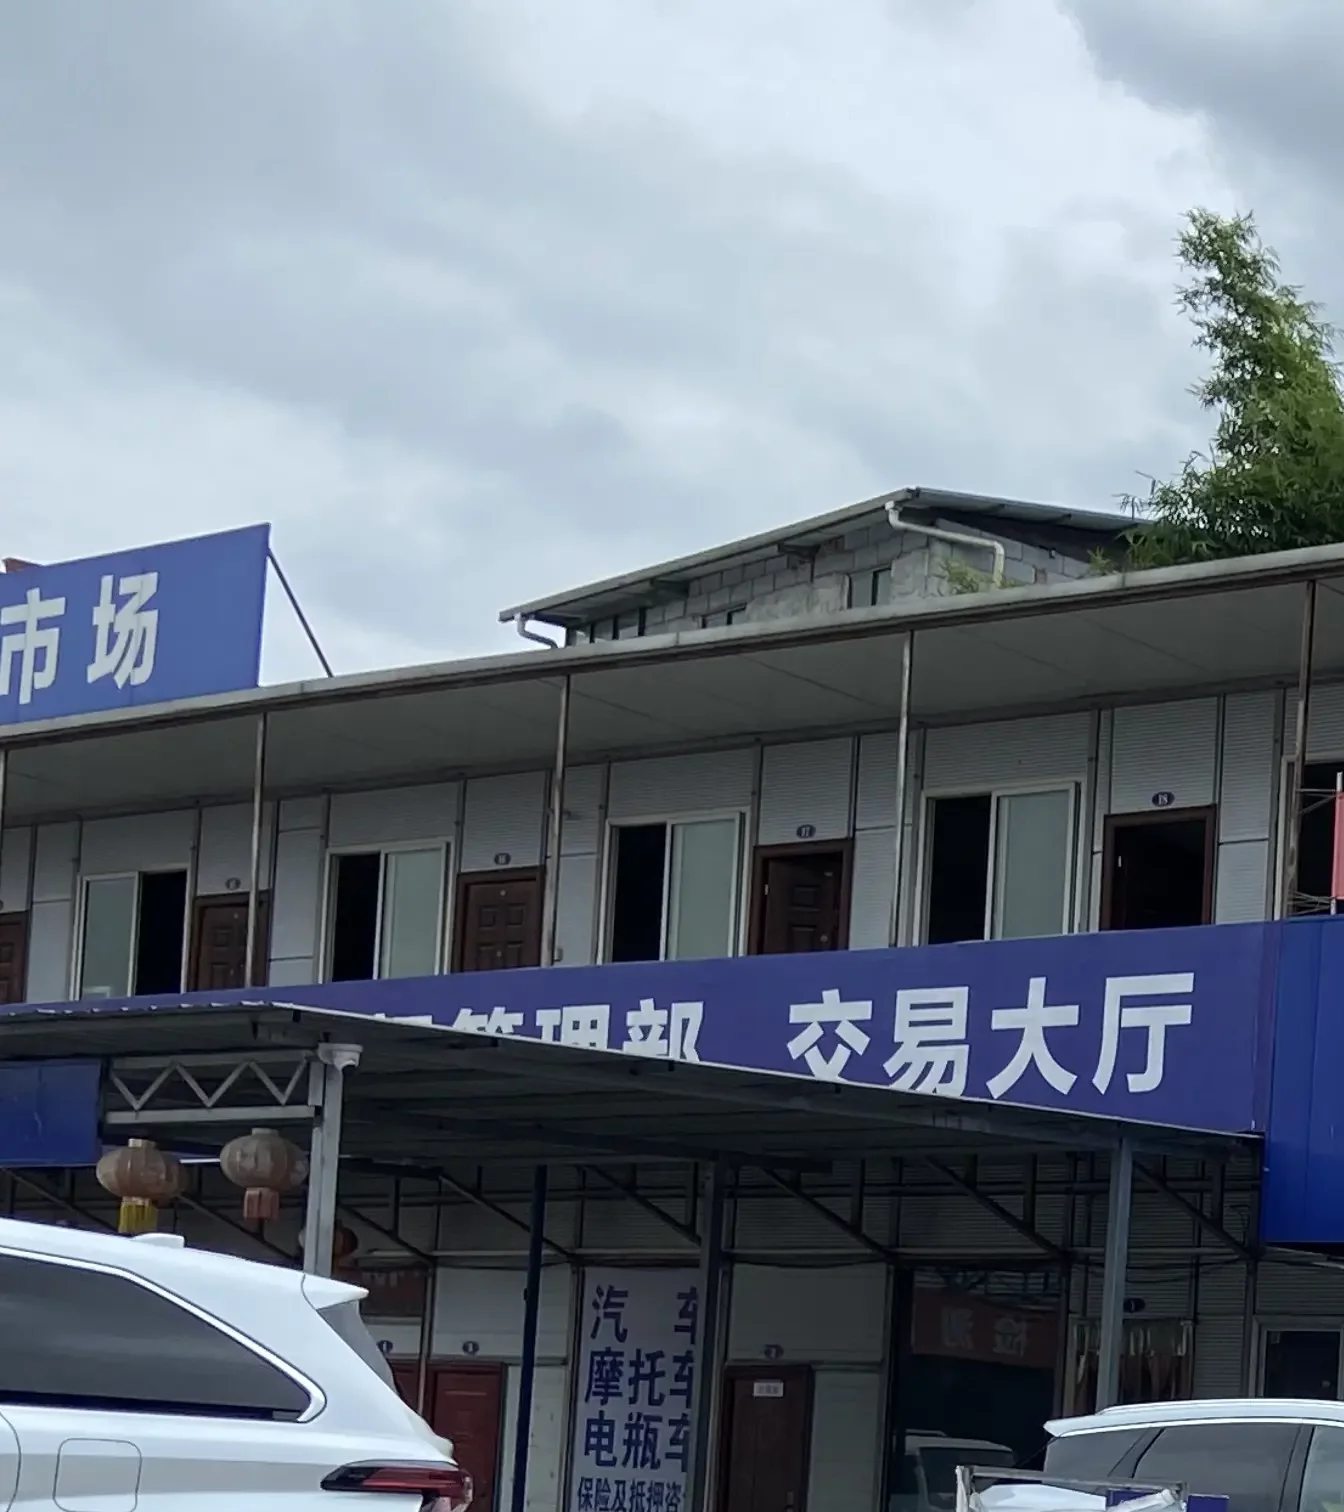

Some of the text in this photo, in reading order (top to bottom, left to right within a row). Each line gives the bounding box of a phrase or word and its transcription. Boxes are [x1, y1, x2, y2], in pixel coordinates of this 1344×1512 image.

[0, 570, 161, 706] 市场
[784, 970, 1195, 1100] 交易大厅
[584, 1346, 694, 1409] 摩托车
[583, 1410, 691, 1473] 电瓶车
